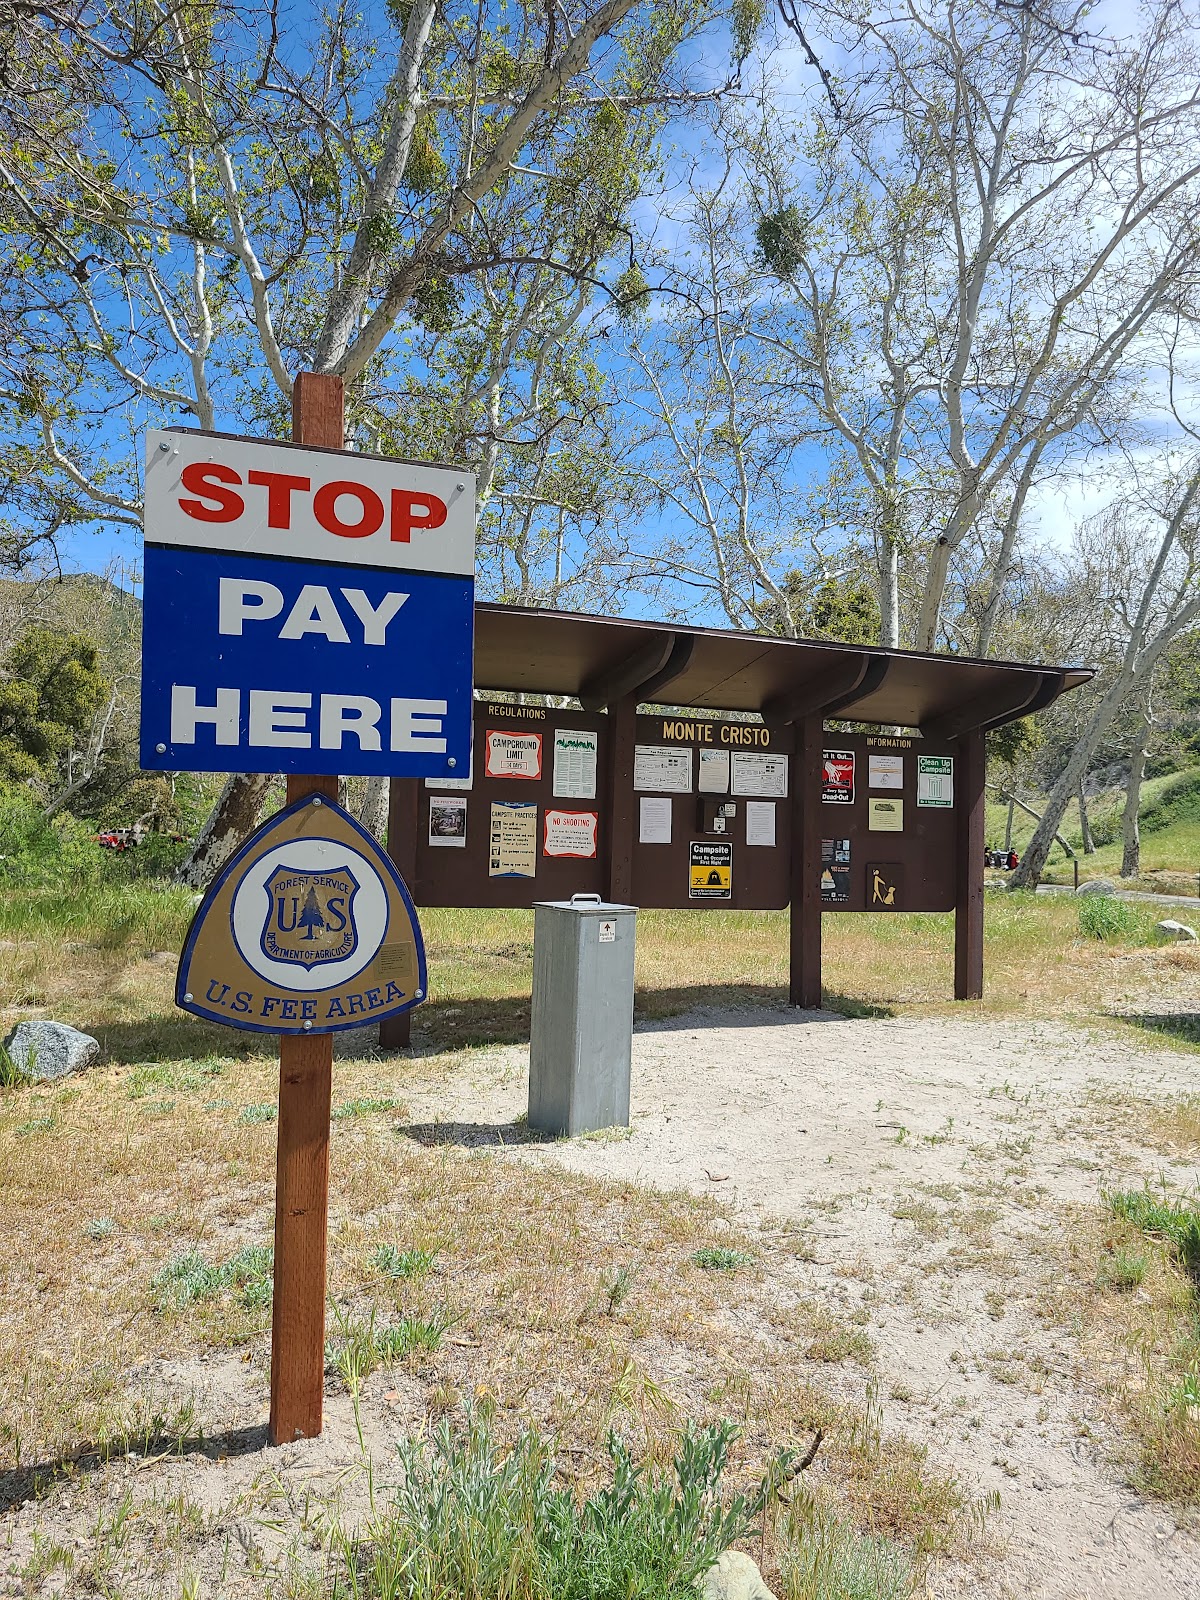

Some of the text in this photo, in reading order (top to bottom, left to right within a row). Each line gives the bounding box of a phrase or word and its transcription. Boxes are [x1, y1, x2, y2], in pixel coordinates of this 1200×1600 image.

[178, 462, 448, 544] STOP
[219, 577, 411, 646] PAY
[170, 685, 447, 753] HERE
[488, 705, 546, 720] REGULATIONS
[662, 721, 770, 746] MONTE CRISTO
[492, 738, 537, 750] CAMPGROUND
[866, 737, 912, 748] INFORMATION
[506, 750, 523, 760] LIMIT
[920, 758, 950, 768] Clean Up
[920, 766, 950, 774] Campsite
[552, 818, 590, 827] NO SHOOTING
[693, 844, 728, 854] Campsite
[274, 876, 350, 895] FOREST SERVICE
[266, 932, 352, 960] DEPARTMENT OF AGRICULTURE
[205, 979, 406, 1020] U.S. FEE AREA
